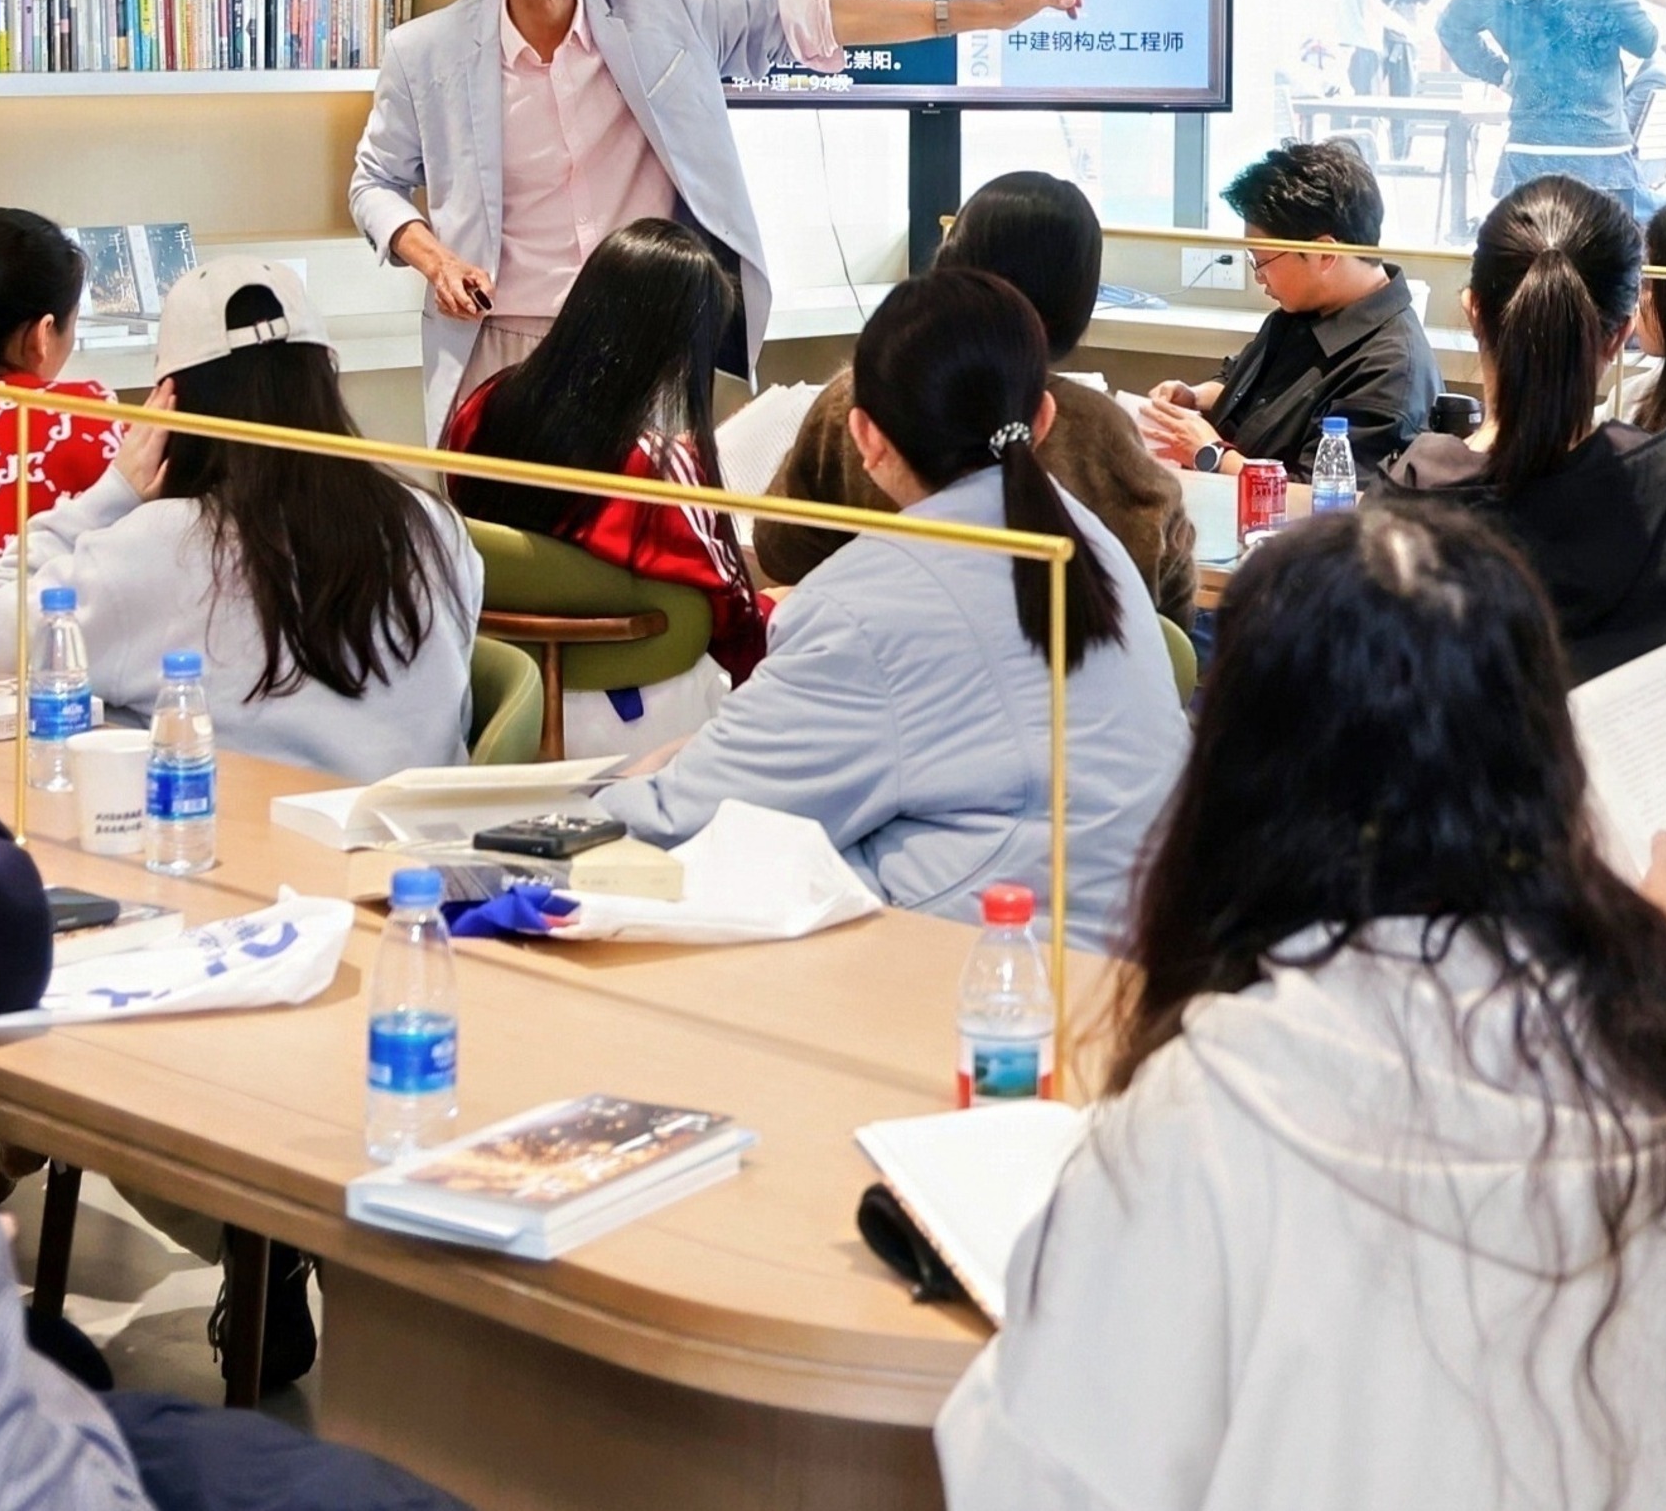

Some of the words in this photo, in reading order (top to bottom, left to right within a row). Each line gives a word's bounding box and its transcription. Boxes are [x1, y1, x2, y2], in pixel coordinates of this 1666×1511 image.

[1008, 31, 1184, 52] 中建钢构总工程师
